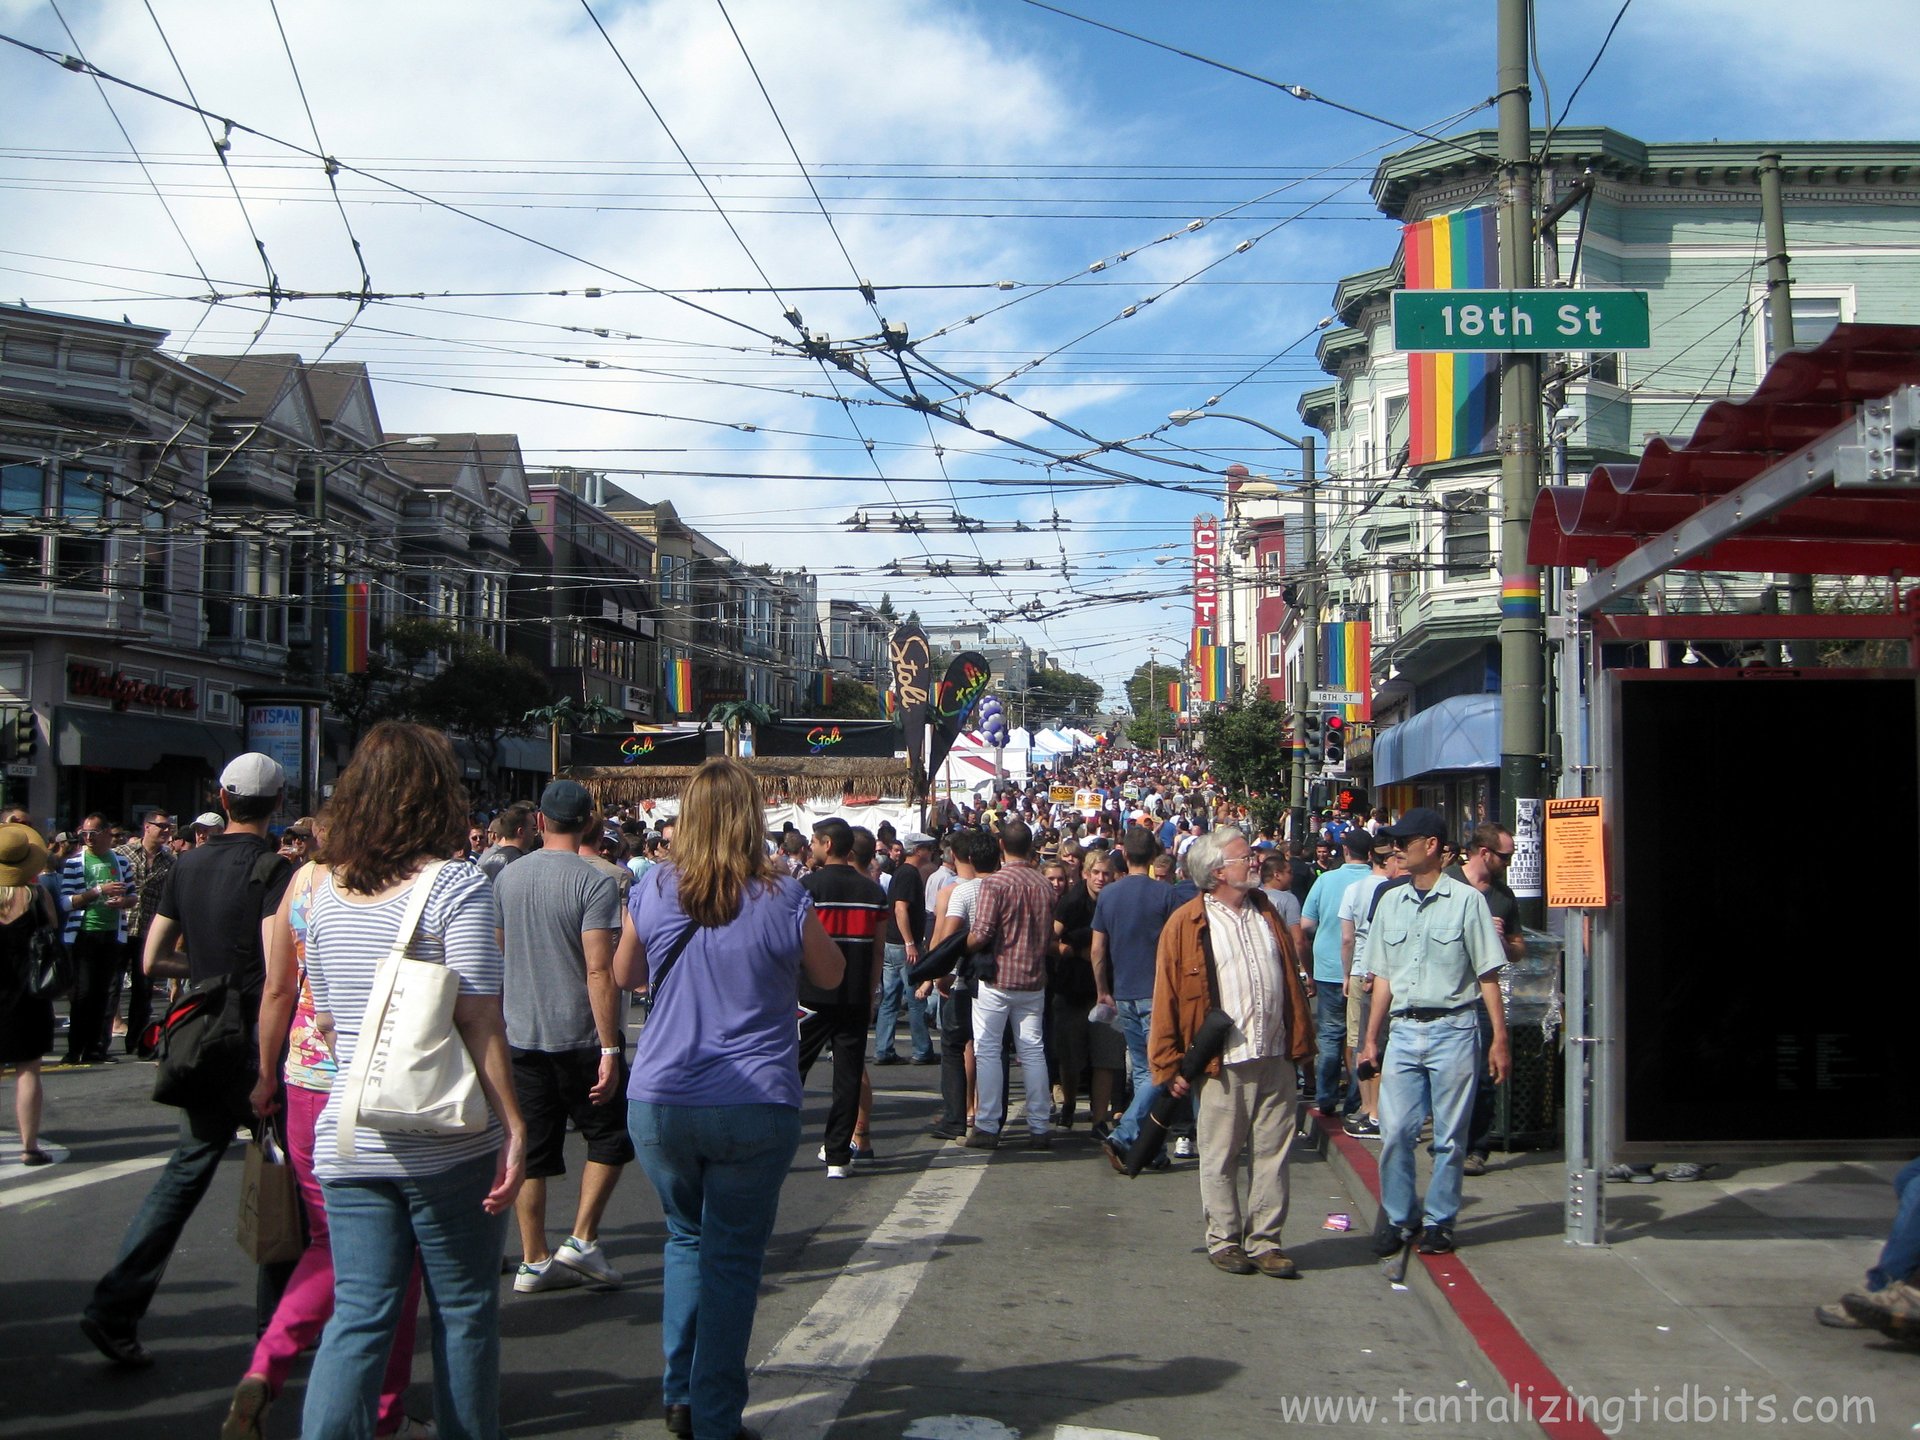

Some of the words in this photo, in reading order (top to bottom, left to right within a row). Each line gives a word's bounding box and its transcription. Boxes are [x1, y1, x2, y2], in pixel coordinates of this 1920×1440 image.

[1441, 305, 1533, 336] 18th
[1556, 304, 1602, 336] St
[1196, 529, 1215, 641] CAST
[890, 634, 931, 711] Stoli
[66, 663, 200, 712] Walgreens
[1319, 692, 1338, 700] 18TH
[1343, 693, 1353, 701] ST
[250, 708, 299, 724] ARTSPAN
[620, 736, 655, 763] Stoli
[807, 726, 842, 754] Stoli
[1051, 786, 1074, 795] ROSS
[1078, 793, 1101, 801] RSS
[368, 987, 405, 1088] TARTINE
